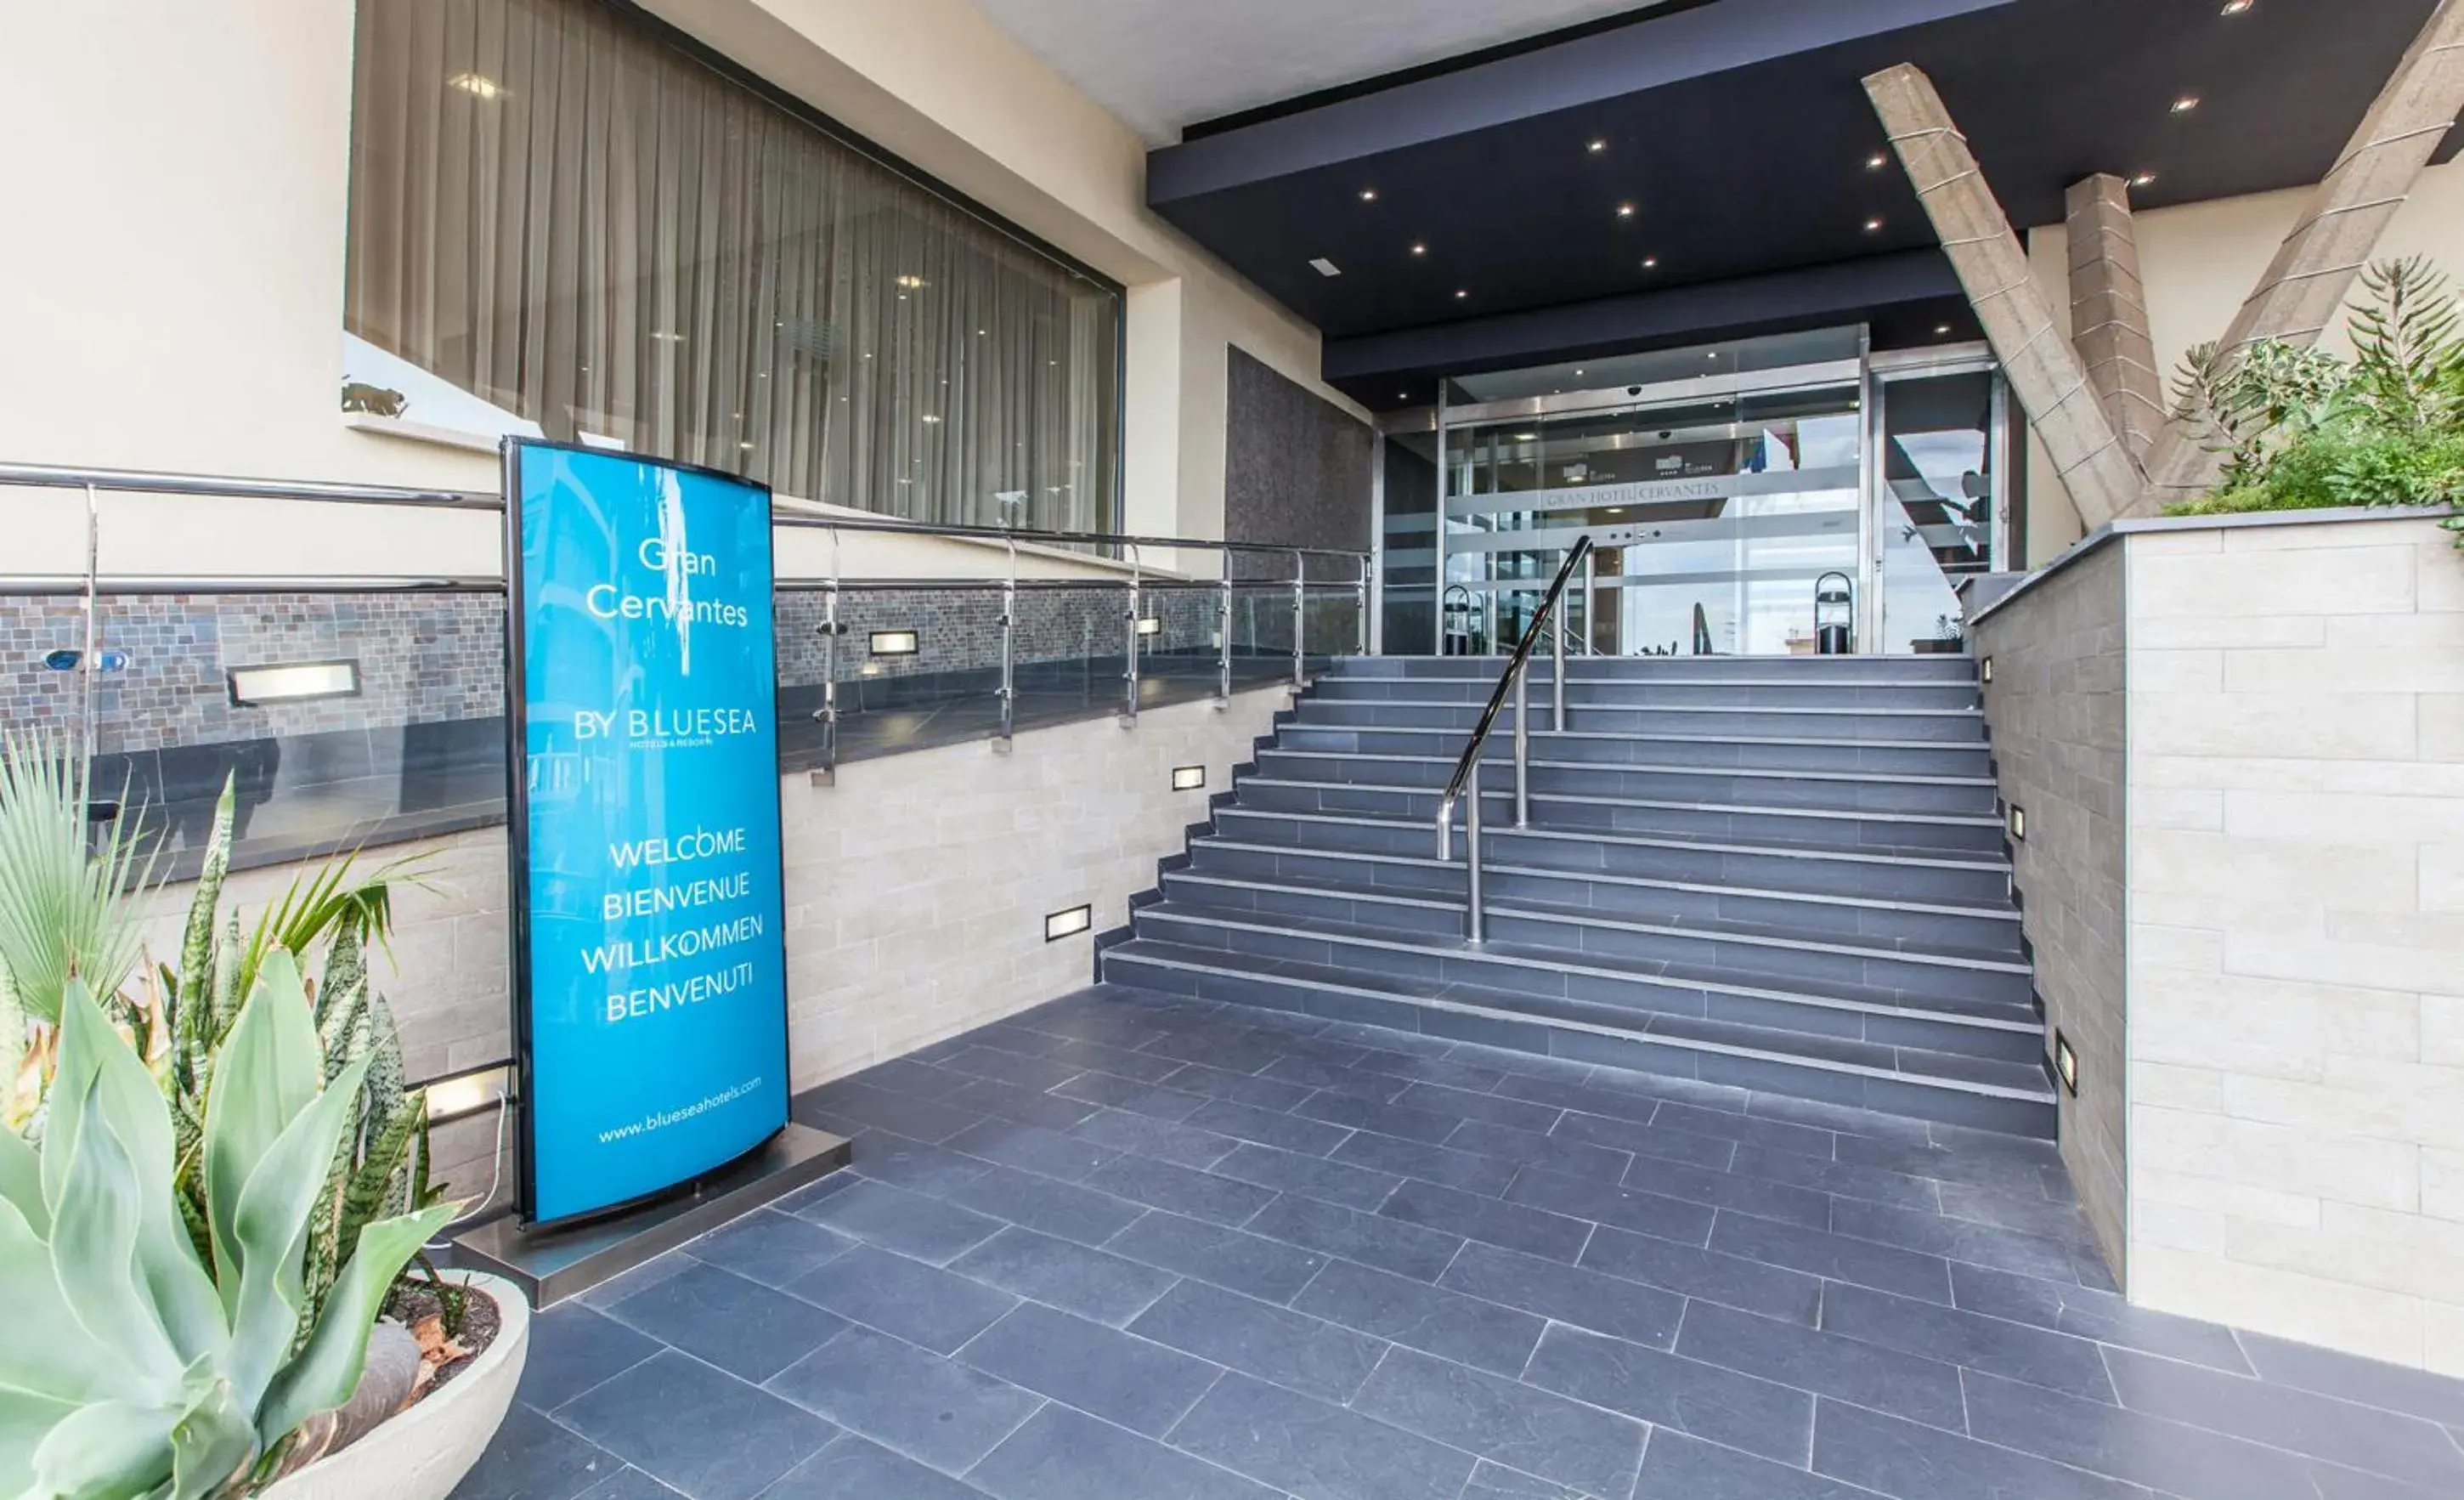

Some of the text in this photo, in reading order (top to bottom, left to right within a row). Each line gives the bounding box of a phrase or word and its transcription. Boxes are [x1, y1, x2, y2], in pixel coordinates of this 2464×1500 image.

[1591, 486, 1636, 504] HOTEL
[638, 537, 715, 576] Gran
[586, 583, 749, 627] Cervantes
[574, 709, 757, 739] BY BLUESEA
[609, 827, 747, 869] WELCOME
[603, 871, 750, 921] BIENVENUE
[580, 913, 764, 975] WILLKOMMEN
[607, 960, 754, 1022] BENVENUTI
[598, 1075, 762, 1144] www.blueseahotels.com
